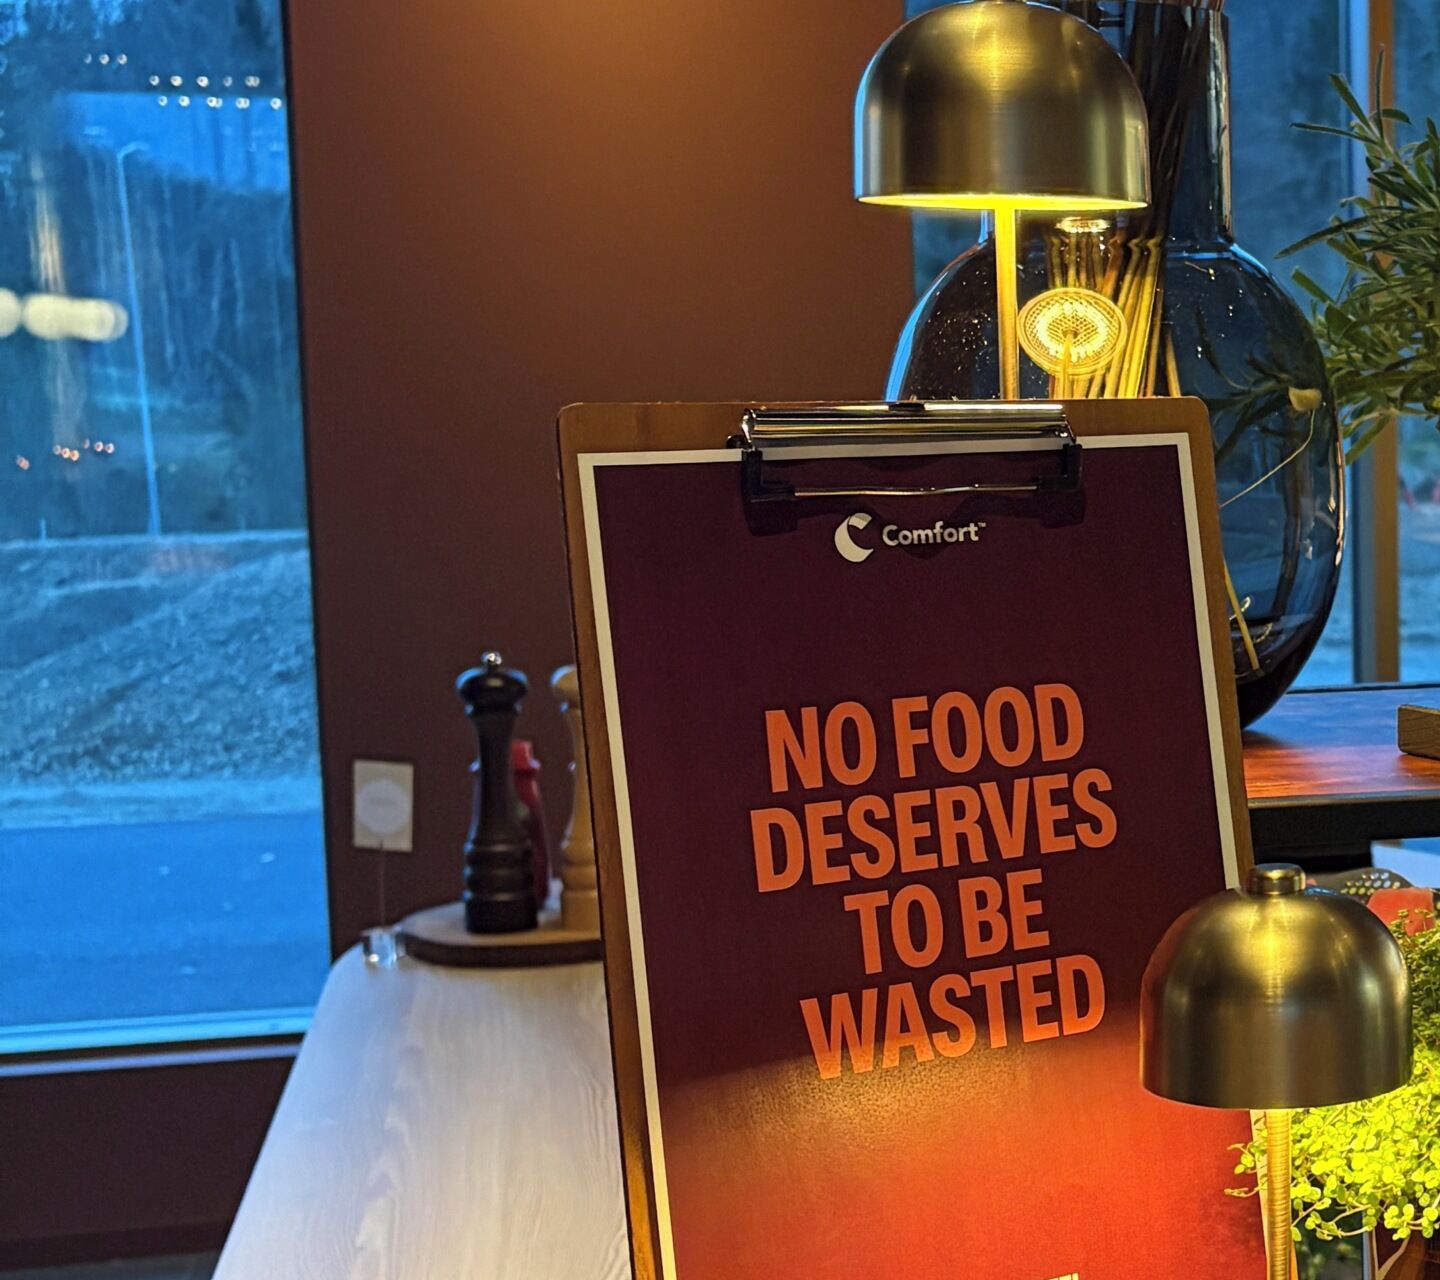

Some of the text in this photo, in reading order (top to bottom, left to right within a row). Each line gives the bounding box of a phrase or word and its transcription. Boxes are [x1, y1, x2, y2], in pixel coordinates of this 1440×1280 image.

[765, 682, 1085, 793] NO FOOD
[750, 767, 1118, 894] DESERVES
[843, 867, 1051, 976] TO BE
[800, 953, 1106, 1081] WASTED
